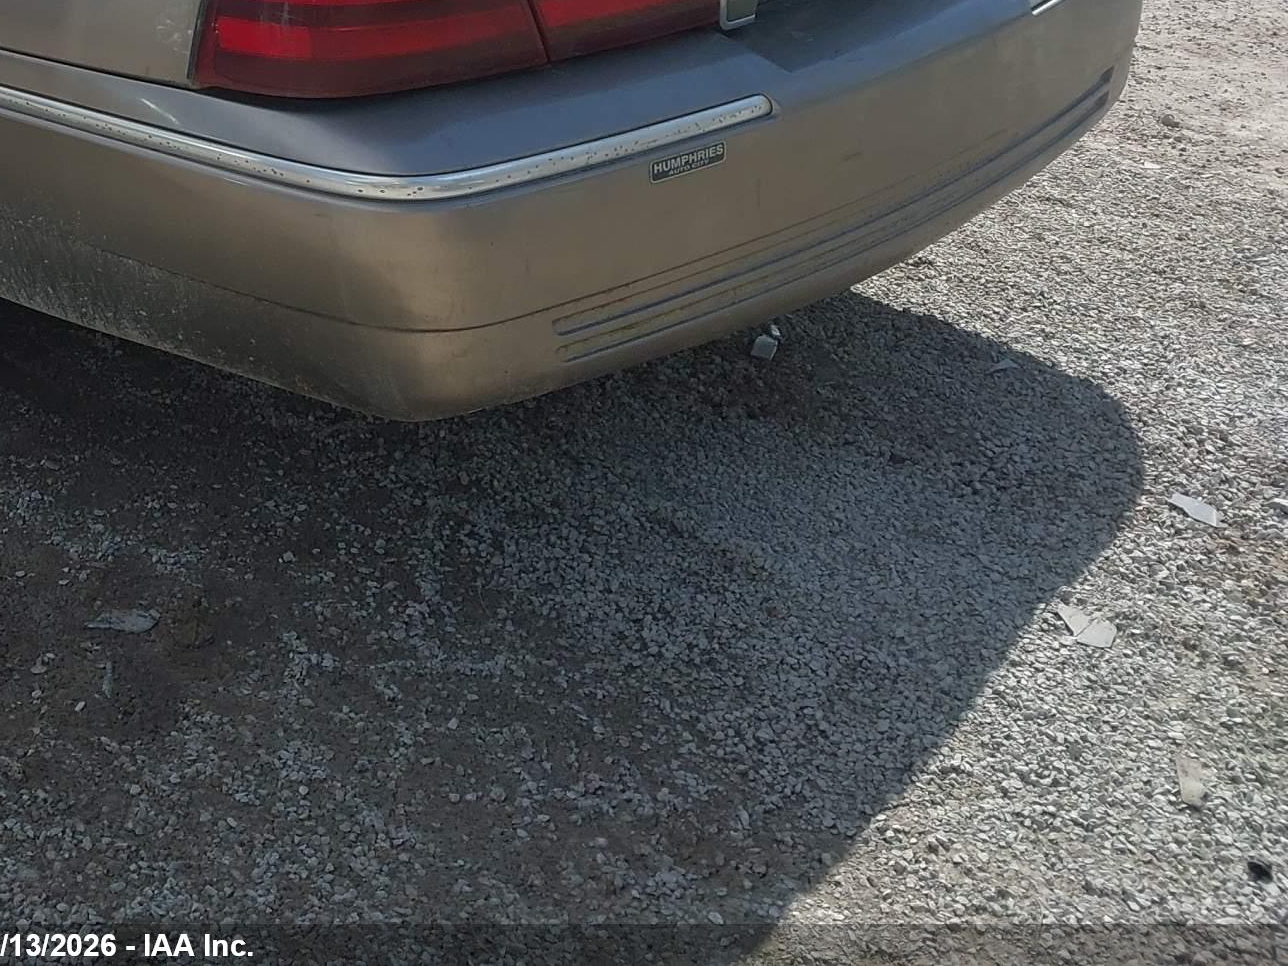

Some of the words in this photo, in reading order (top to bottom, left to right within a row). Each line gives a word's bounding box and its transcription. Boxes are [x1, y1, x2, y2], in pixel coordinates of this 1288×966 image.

[653, 144, 724, 174] HUMPHRIES
[669, 165, 690, 175] AUTO
[692, 159, 710, 169] CITY
